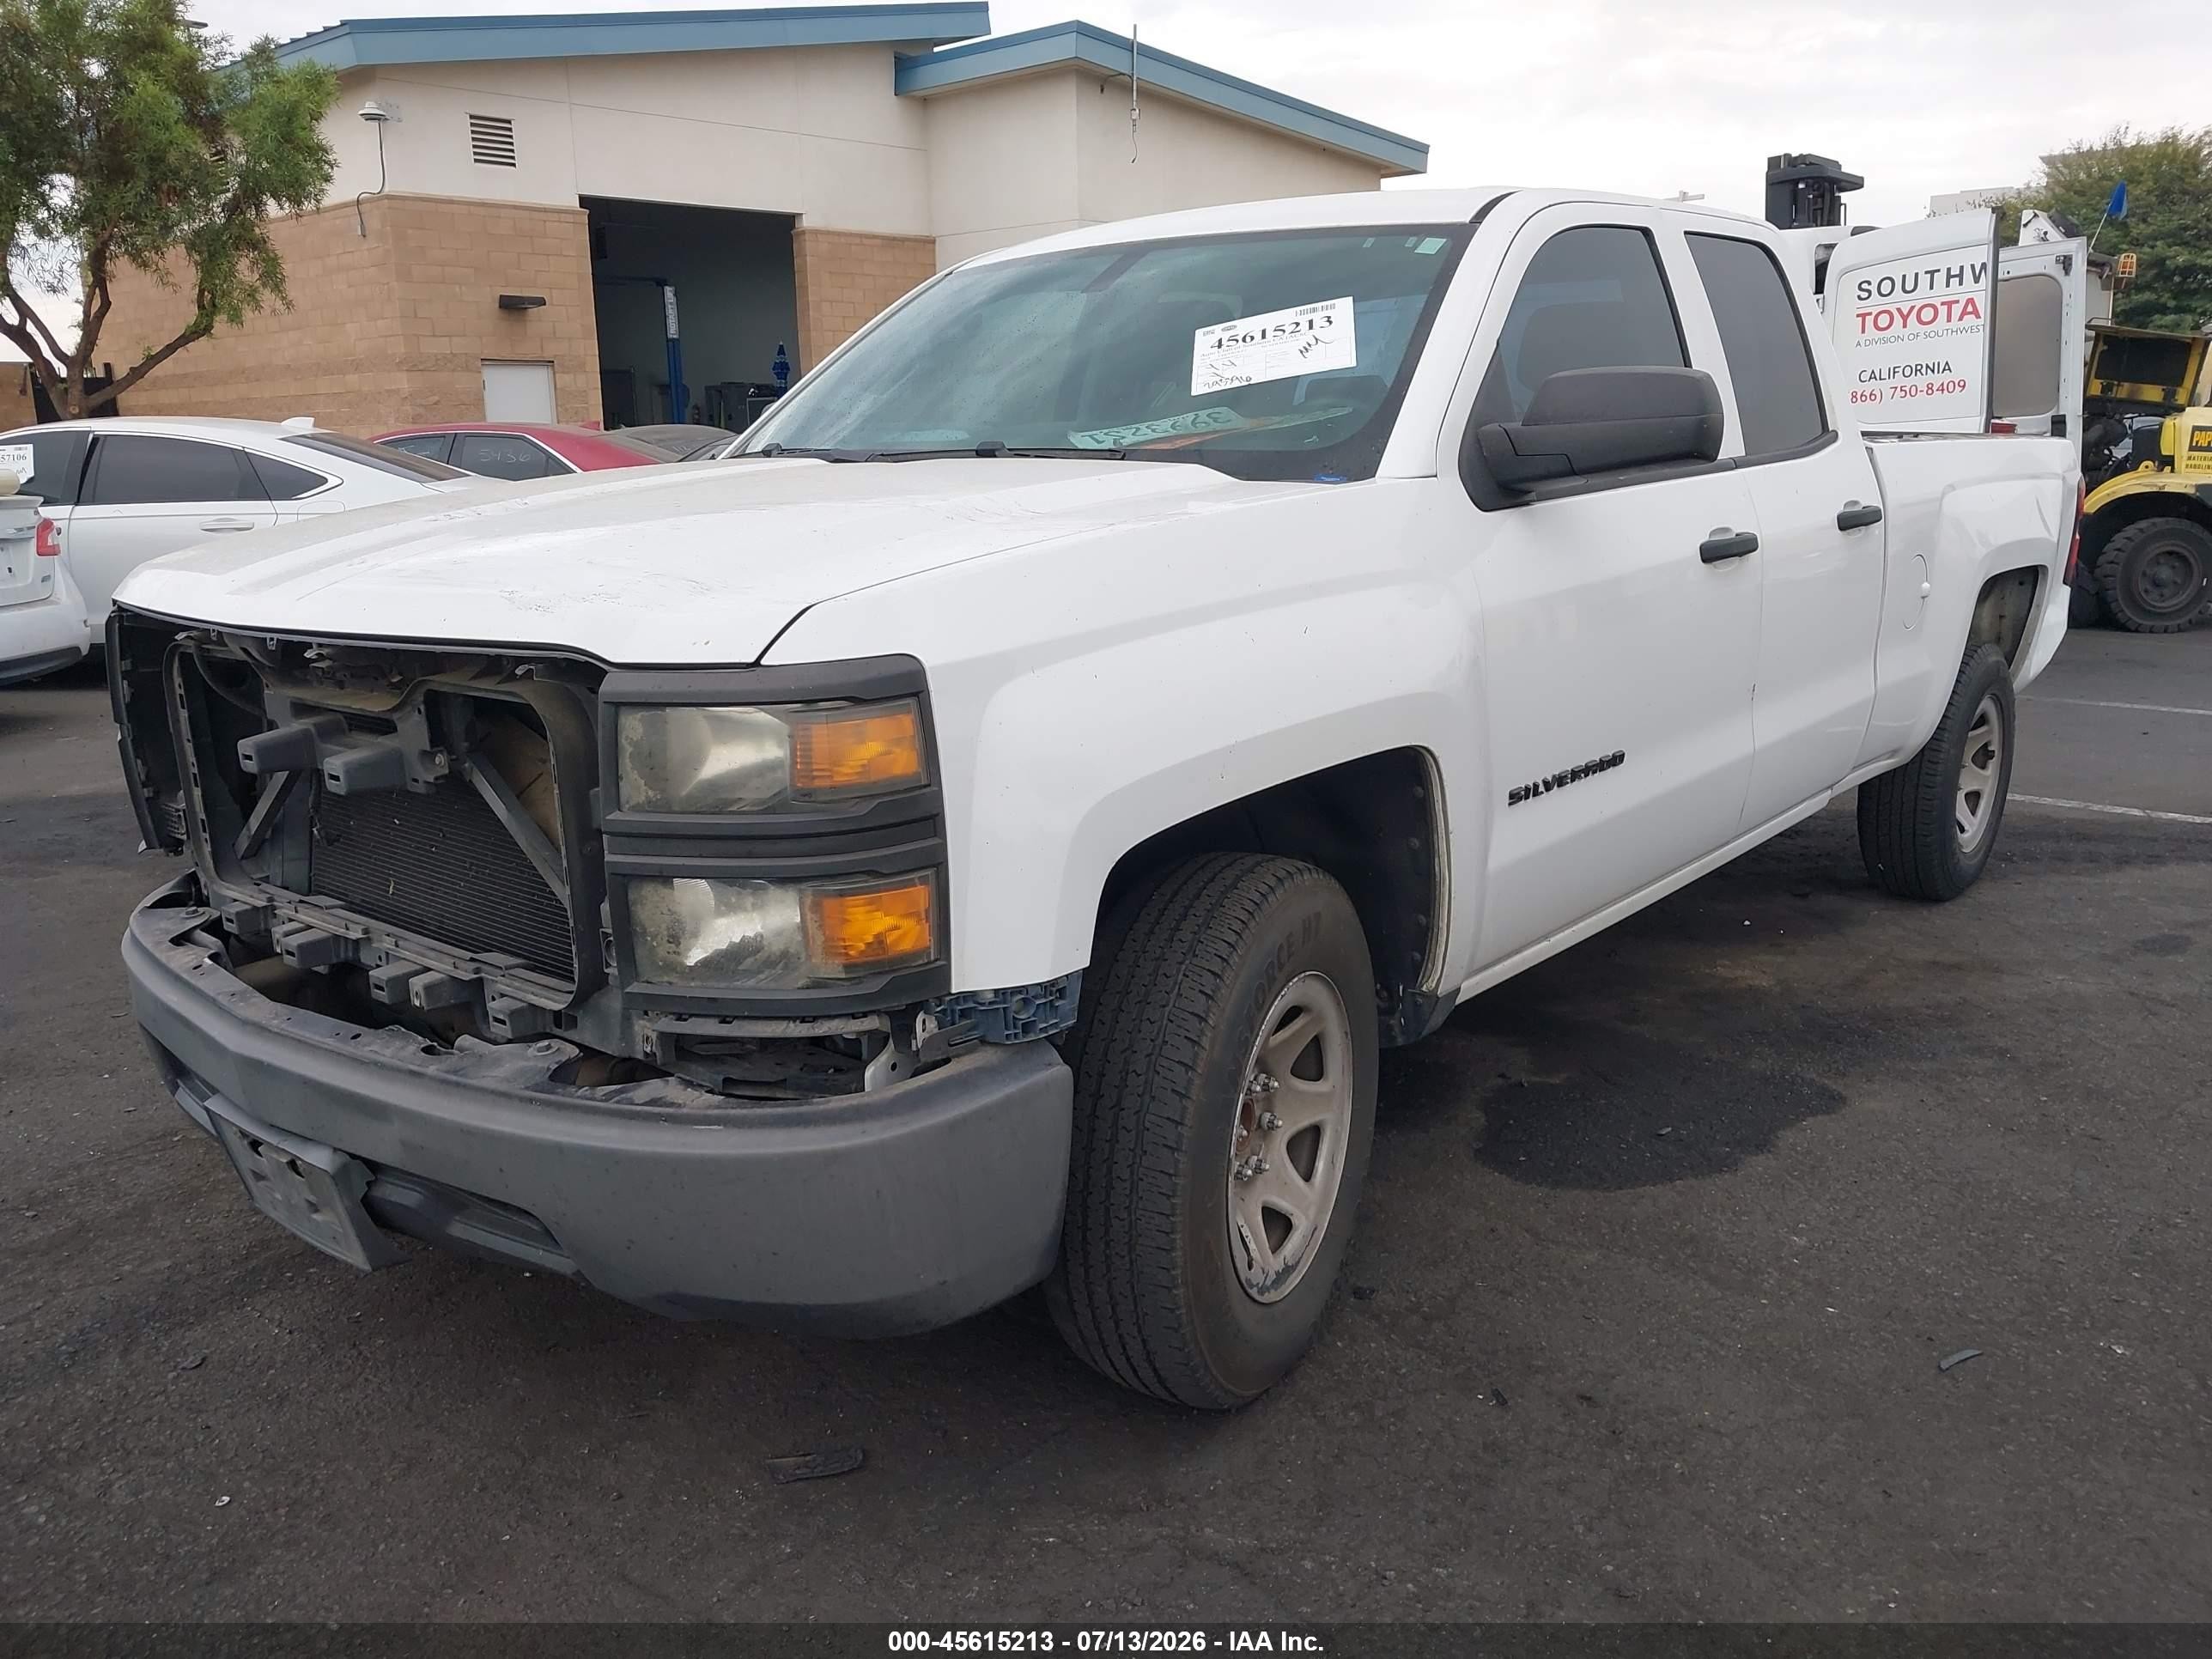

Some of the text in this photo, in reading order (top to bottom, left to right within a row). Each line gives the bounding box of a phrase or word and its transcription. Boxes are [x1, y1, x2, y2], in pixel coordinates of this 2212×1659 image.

[1856, 297, 1982, 334] TOYOTA
[1210, 315, 1334, 349] 45615213
[1855, 340, 1863, 349] A
[1864, 335, 1905, 348] DIVISION
[1907, 332, 1921, 342] OF
[1858, 361, 1953, 383] CALIFORNIA
[1889, 379, 1967, 400] 750-8409
[2193, 430, 2212, 447] PAP
[1507, 750, 1626, 807] SILVERADO
